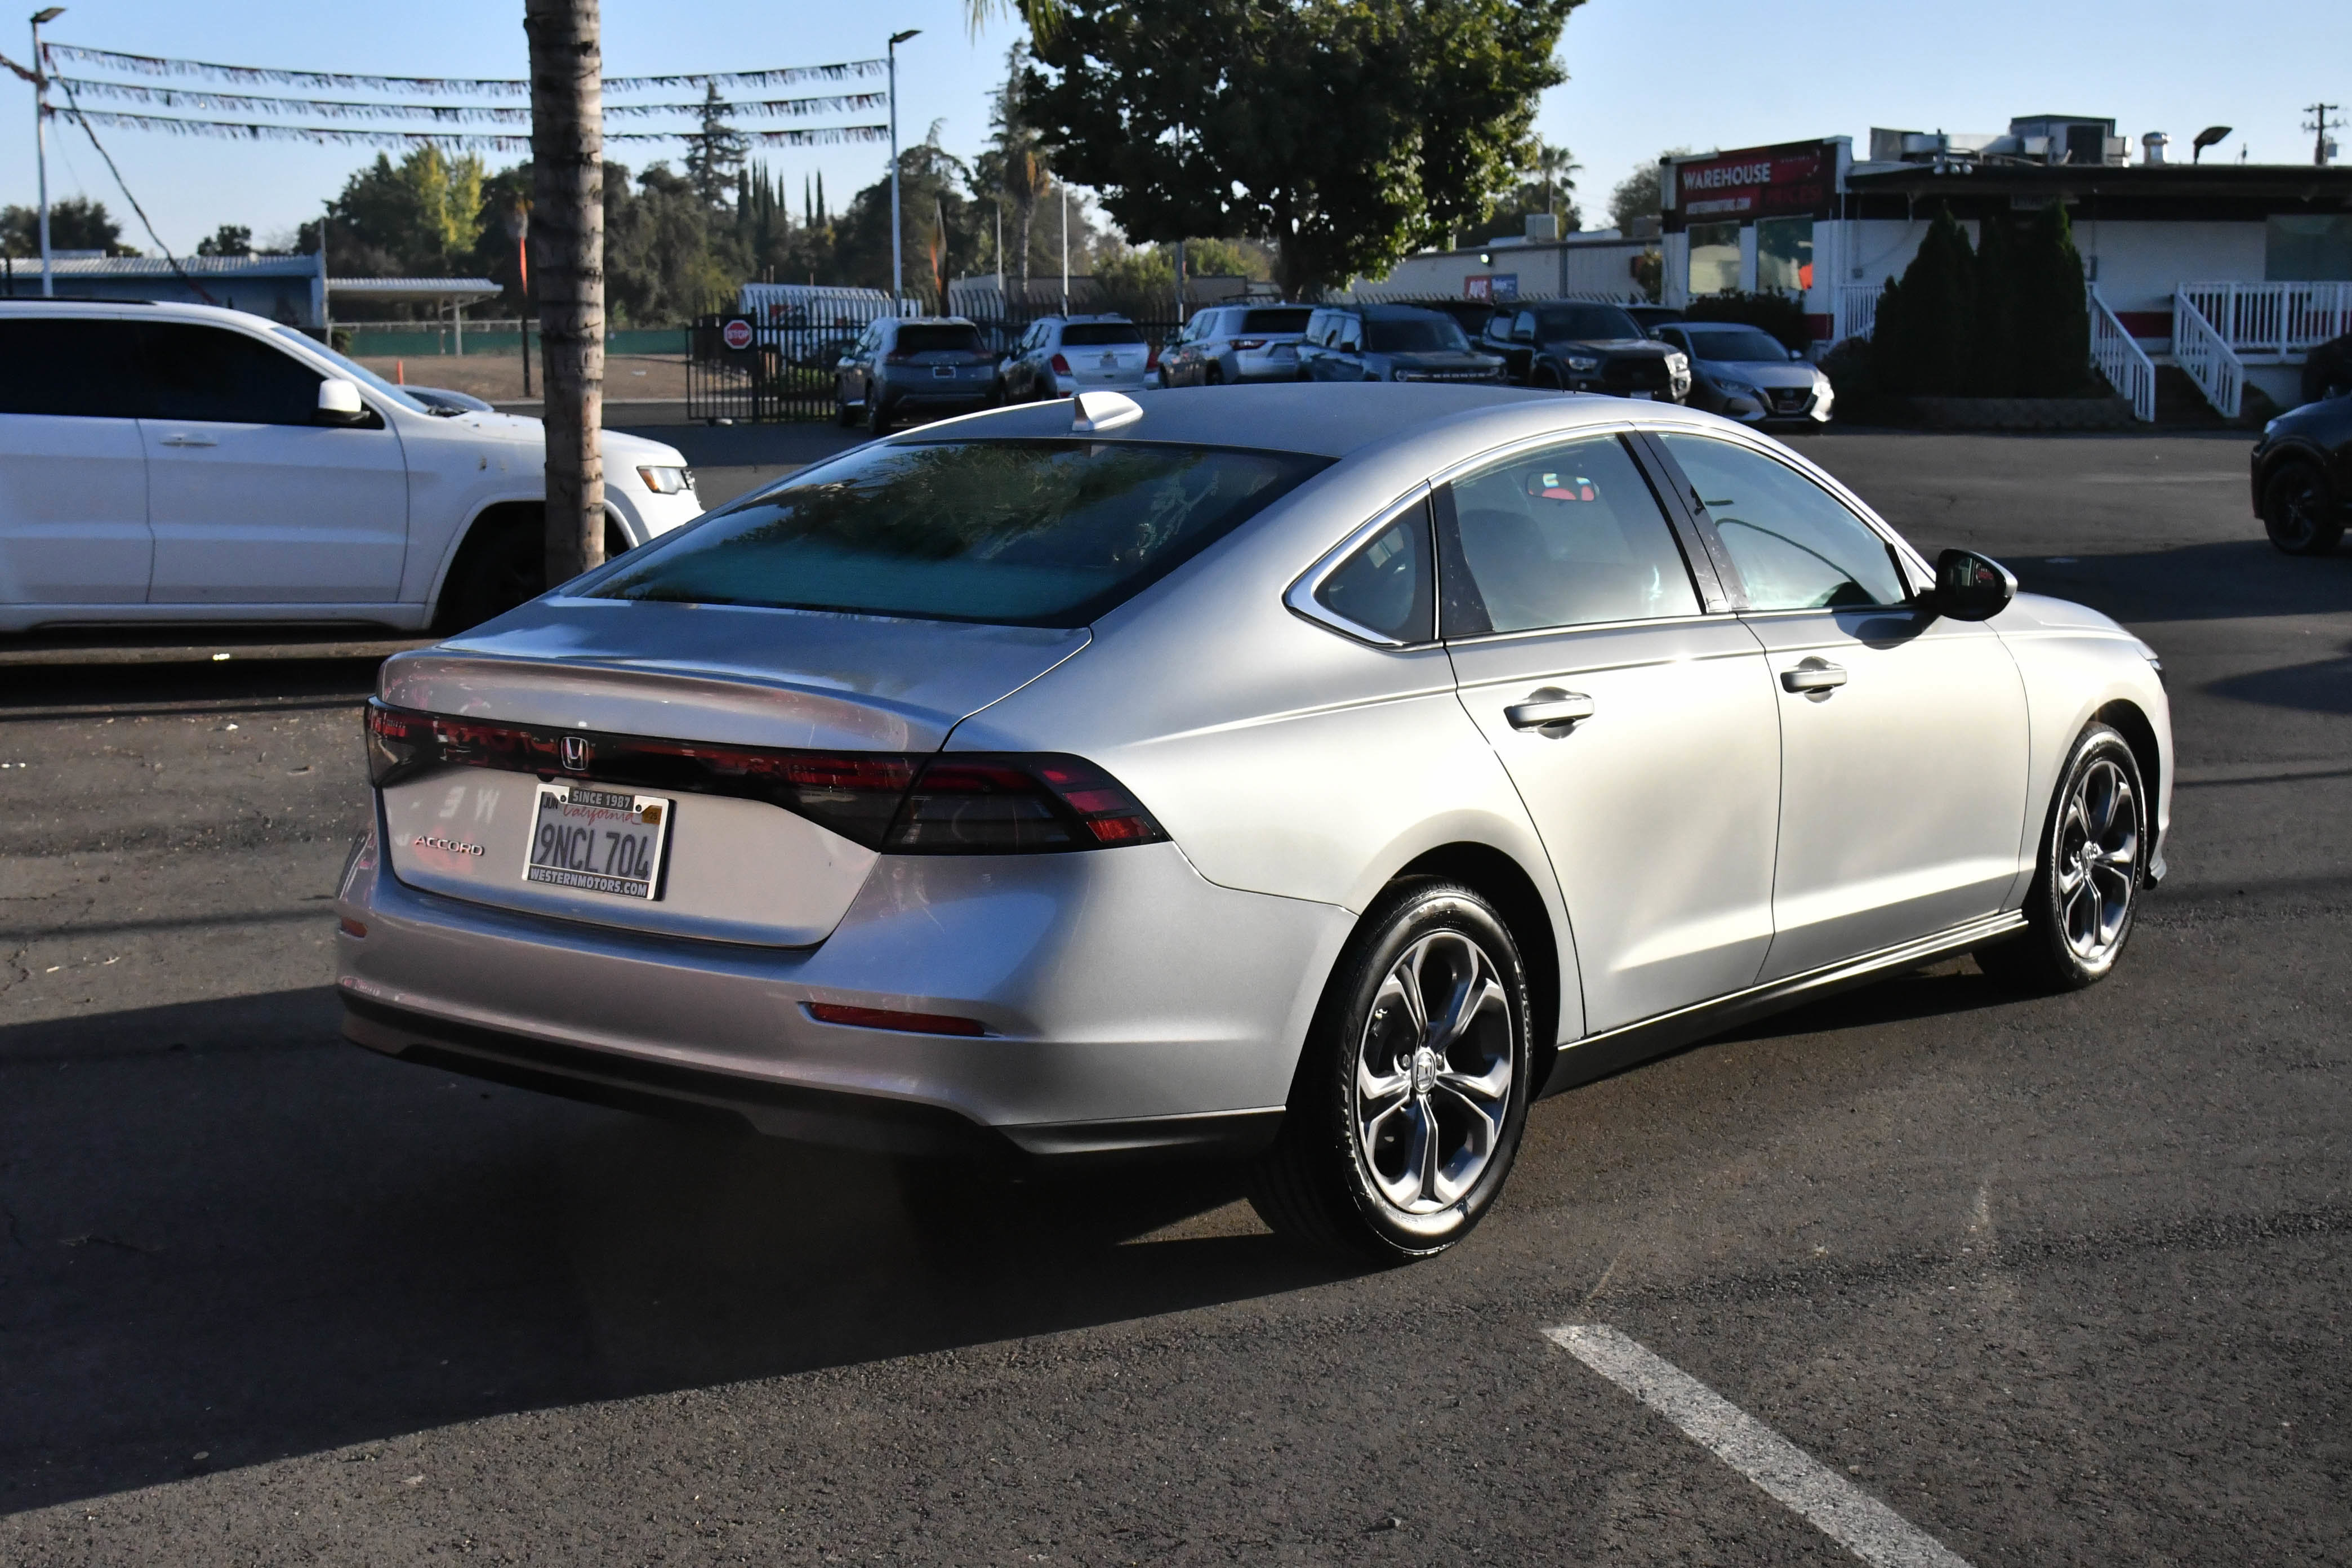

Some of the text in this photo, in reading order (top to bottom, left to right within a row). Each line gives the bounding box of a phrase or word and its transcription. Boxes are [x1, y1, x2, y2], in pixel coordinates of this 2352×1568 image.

[1683, 163, 1771, 190] WAREHOUSE
[728, 329, 749, 340] STOP
[543, 796, 558, 809] JUN
[573, 790, 631, 809] SINCE 1987
[563, 804, 641, 826] California
[415, 835, 485, 857] ACCORD
[530, 868, 647, 897] WESTERNMOTORS.COM
